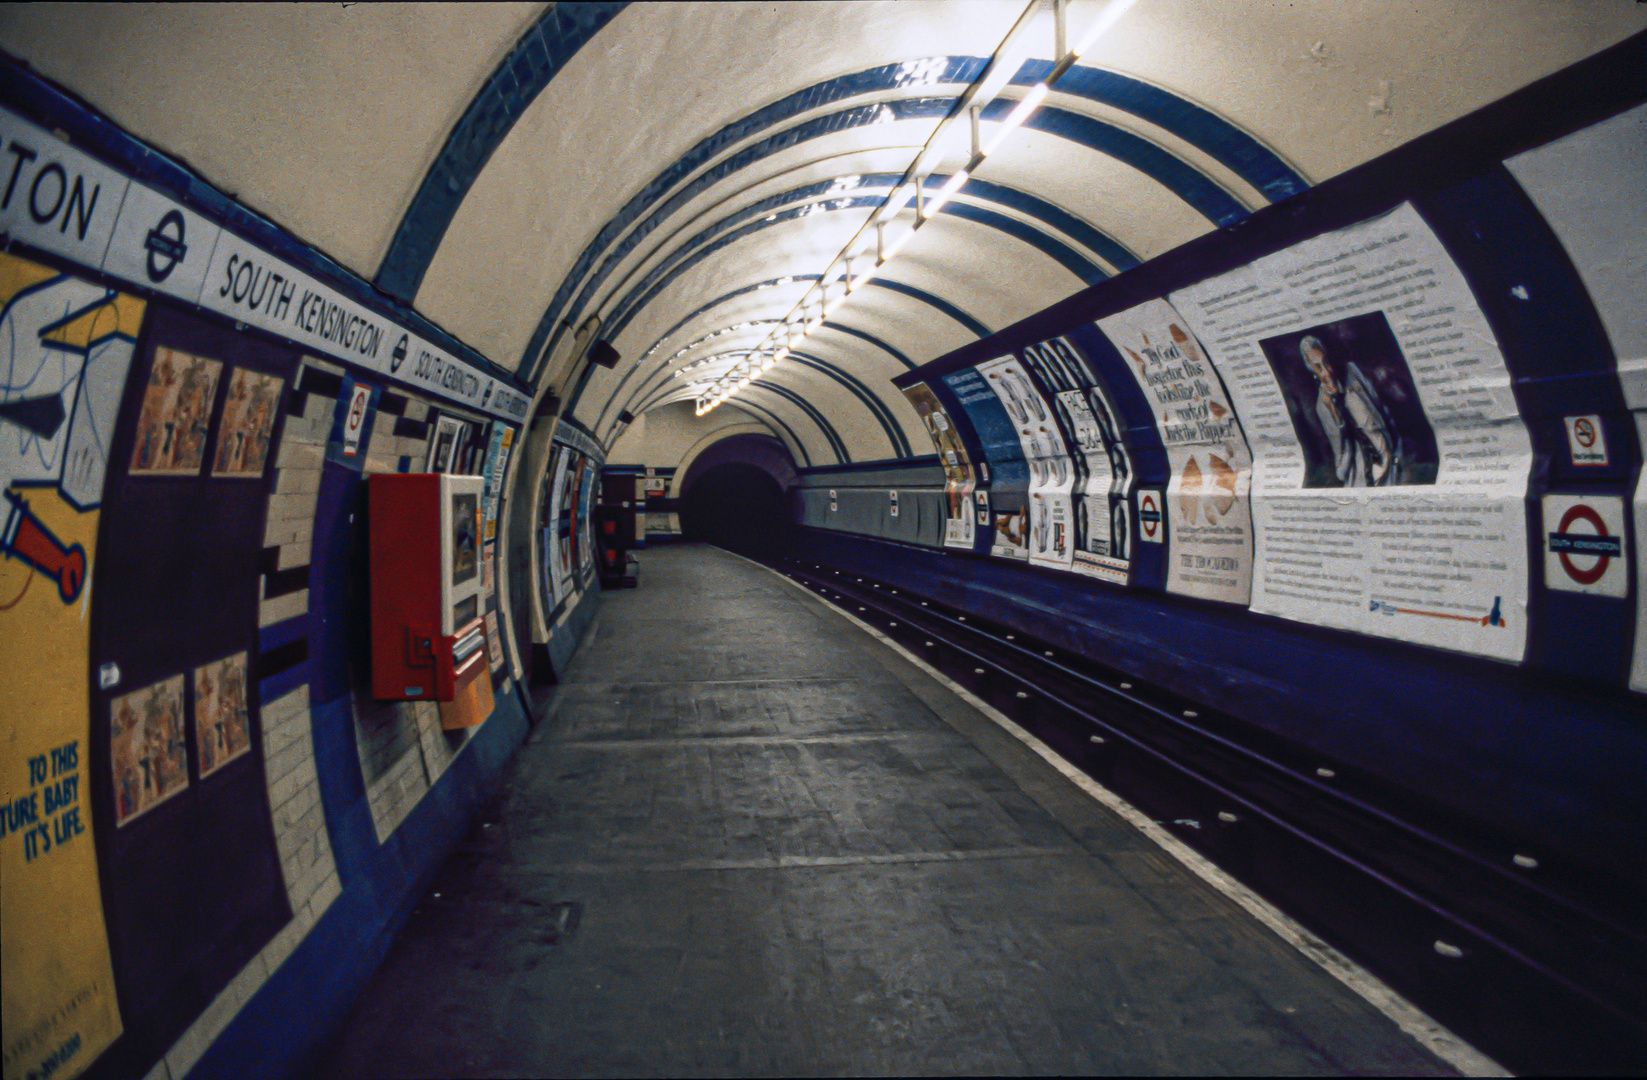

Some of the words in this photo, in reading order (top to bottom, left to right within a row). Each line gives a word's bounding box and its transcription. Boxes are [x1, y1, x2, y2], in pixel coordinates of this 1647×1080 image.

[219, 253, 296, 321] SOUTH
[295, 289, 385, 359] KENSINGTON
[28, 753, 47, 788] TO
[50, 740, 79, 778] THIS
[43, 772, 79, 816] BABY
[24, 822, 51, 863] IT'S
